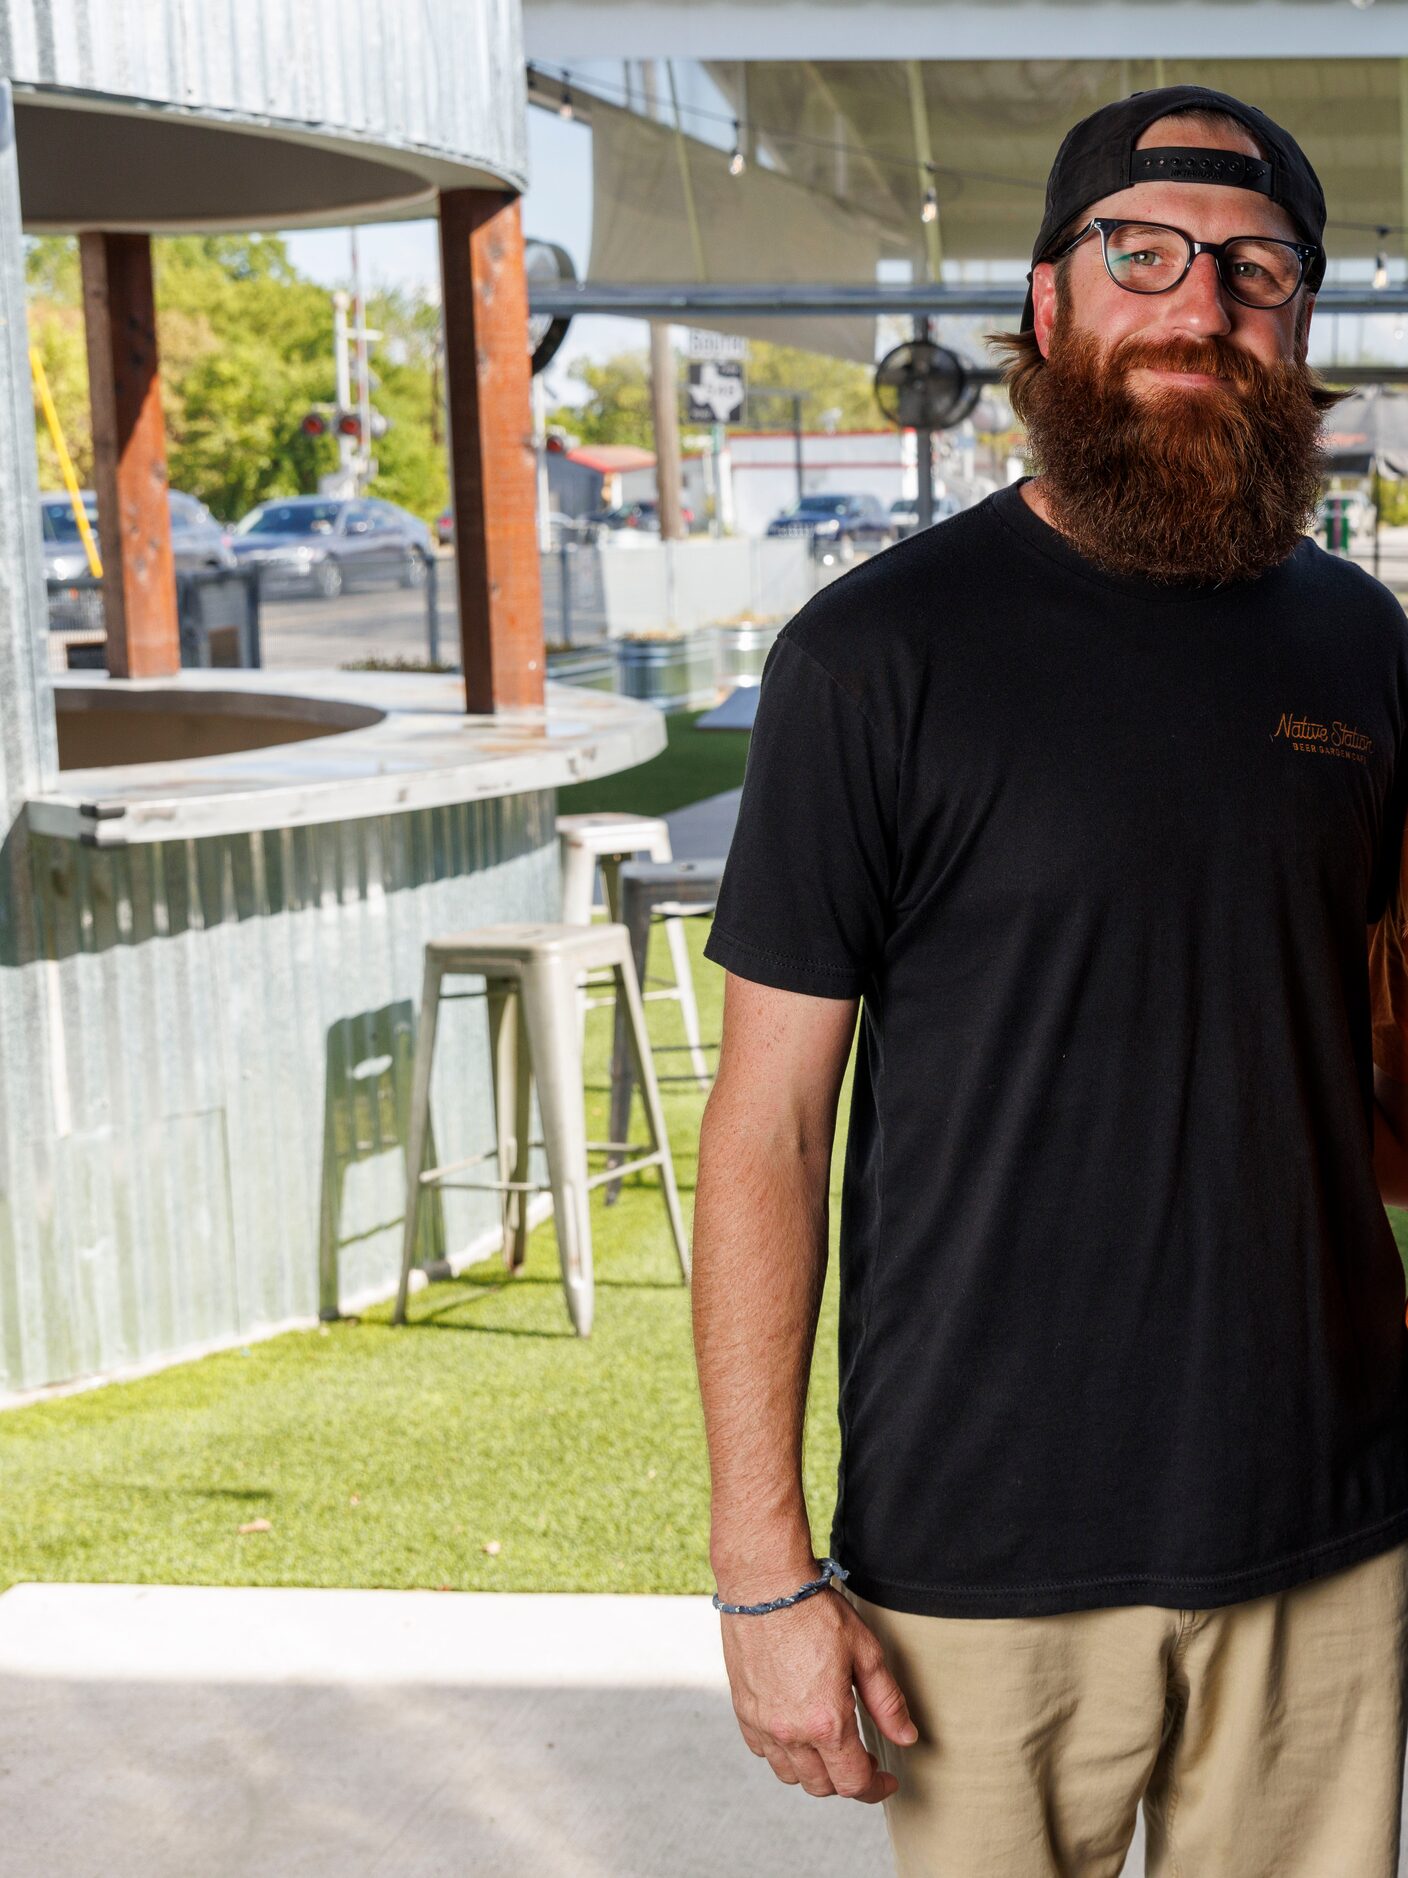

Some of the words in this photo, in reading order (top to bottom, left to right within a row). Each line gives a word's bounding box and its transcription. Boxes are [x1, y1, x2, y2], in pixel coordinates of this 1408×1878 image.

[1274, 713, 1328, 742] Native
[1331, 721, 1374, 754] Station
[1292, 742, 1317, 753] BEER
